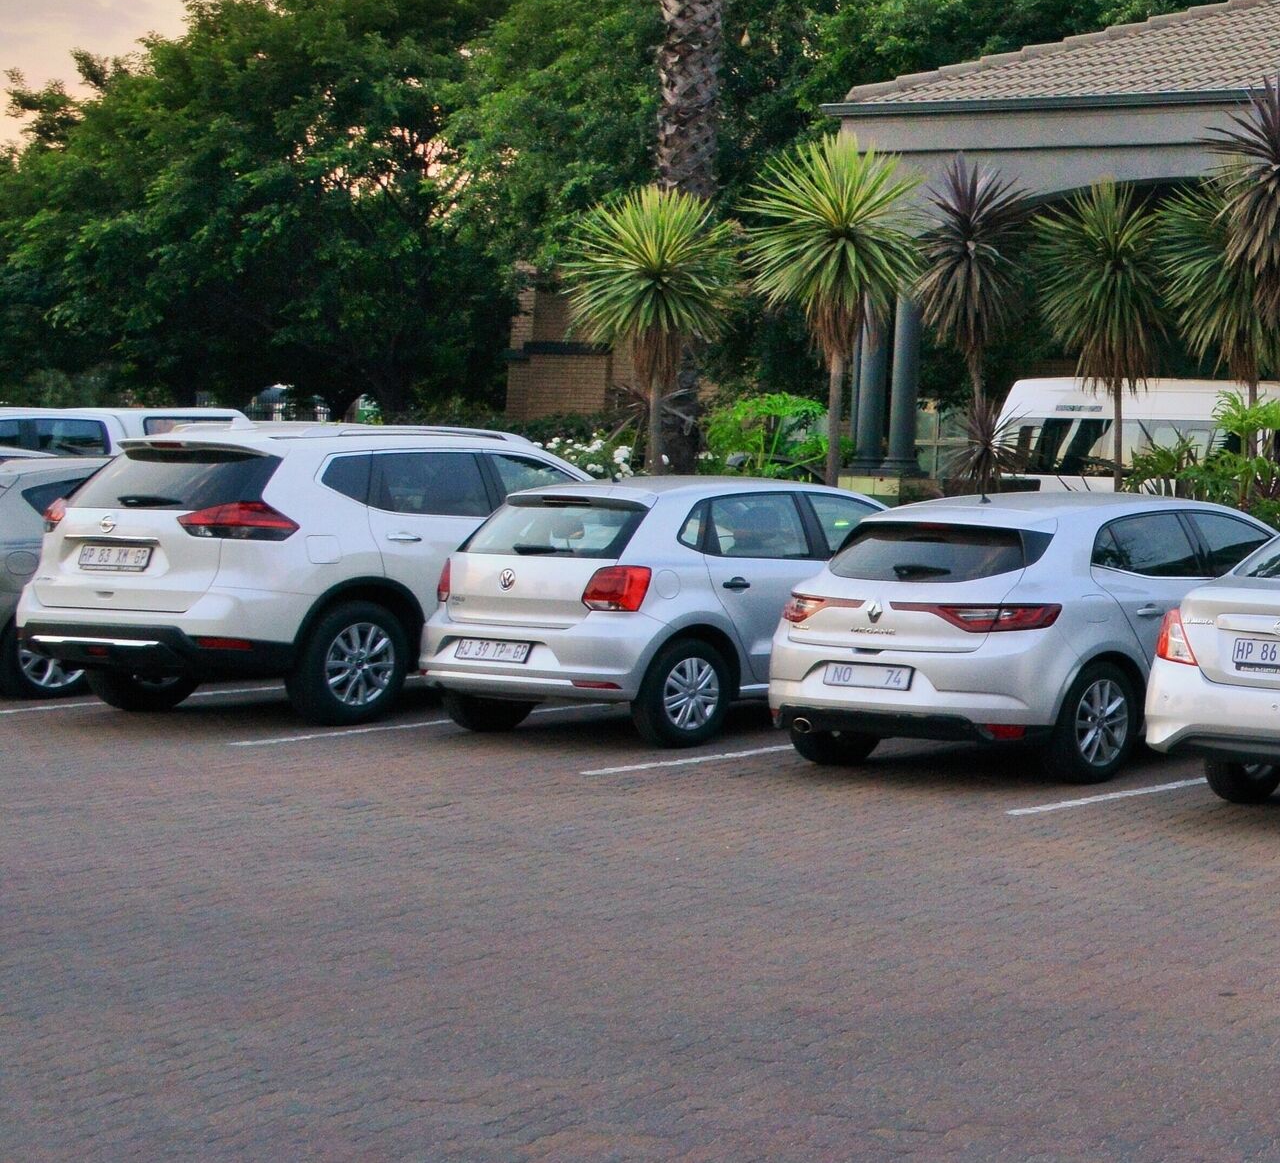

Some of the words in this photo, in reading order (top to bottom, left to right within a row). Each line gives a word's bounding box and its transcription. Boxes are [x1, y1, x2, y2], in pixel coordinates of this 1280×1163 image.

[82, 548, 95, 562] HP
[134, 550, 147, 565] GP
[458, 640, 473, 656] HJ
[475, 641, 490, 657] 39
[493, 642, 507, 658] TP
[513, 644, 528, 660] GP
[1235, 641, 1254, 661] HP
[1260, 643, 1277, 662] 86
[884, 669, 902, 686] 74
